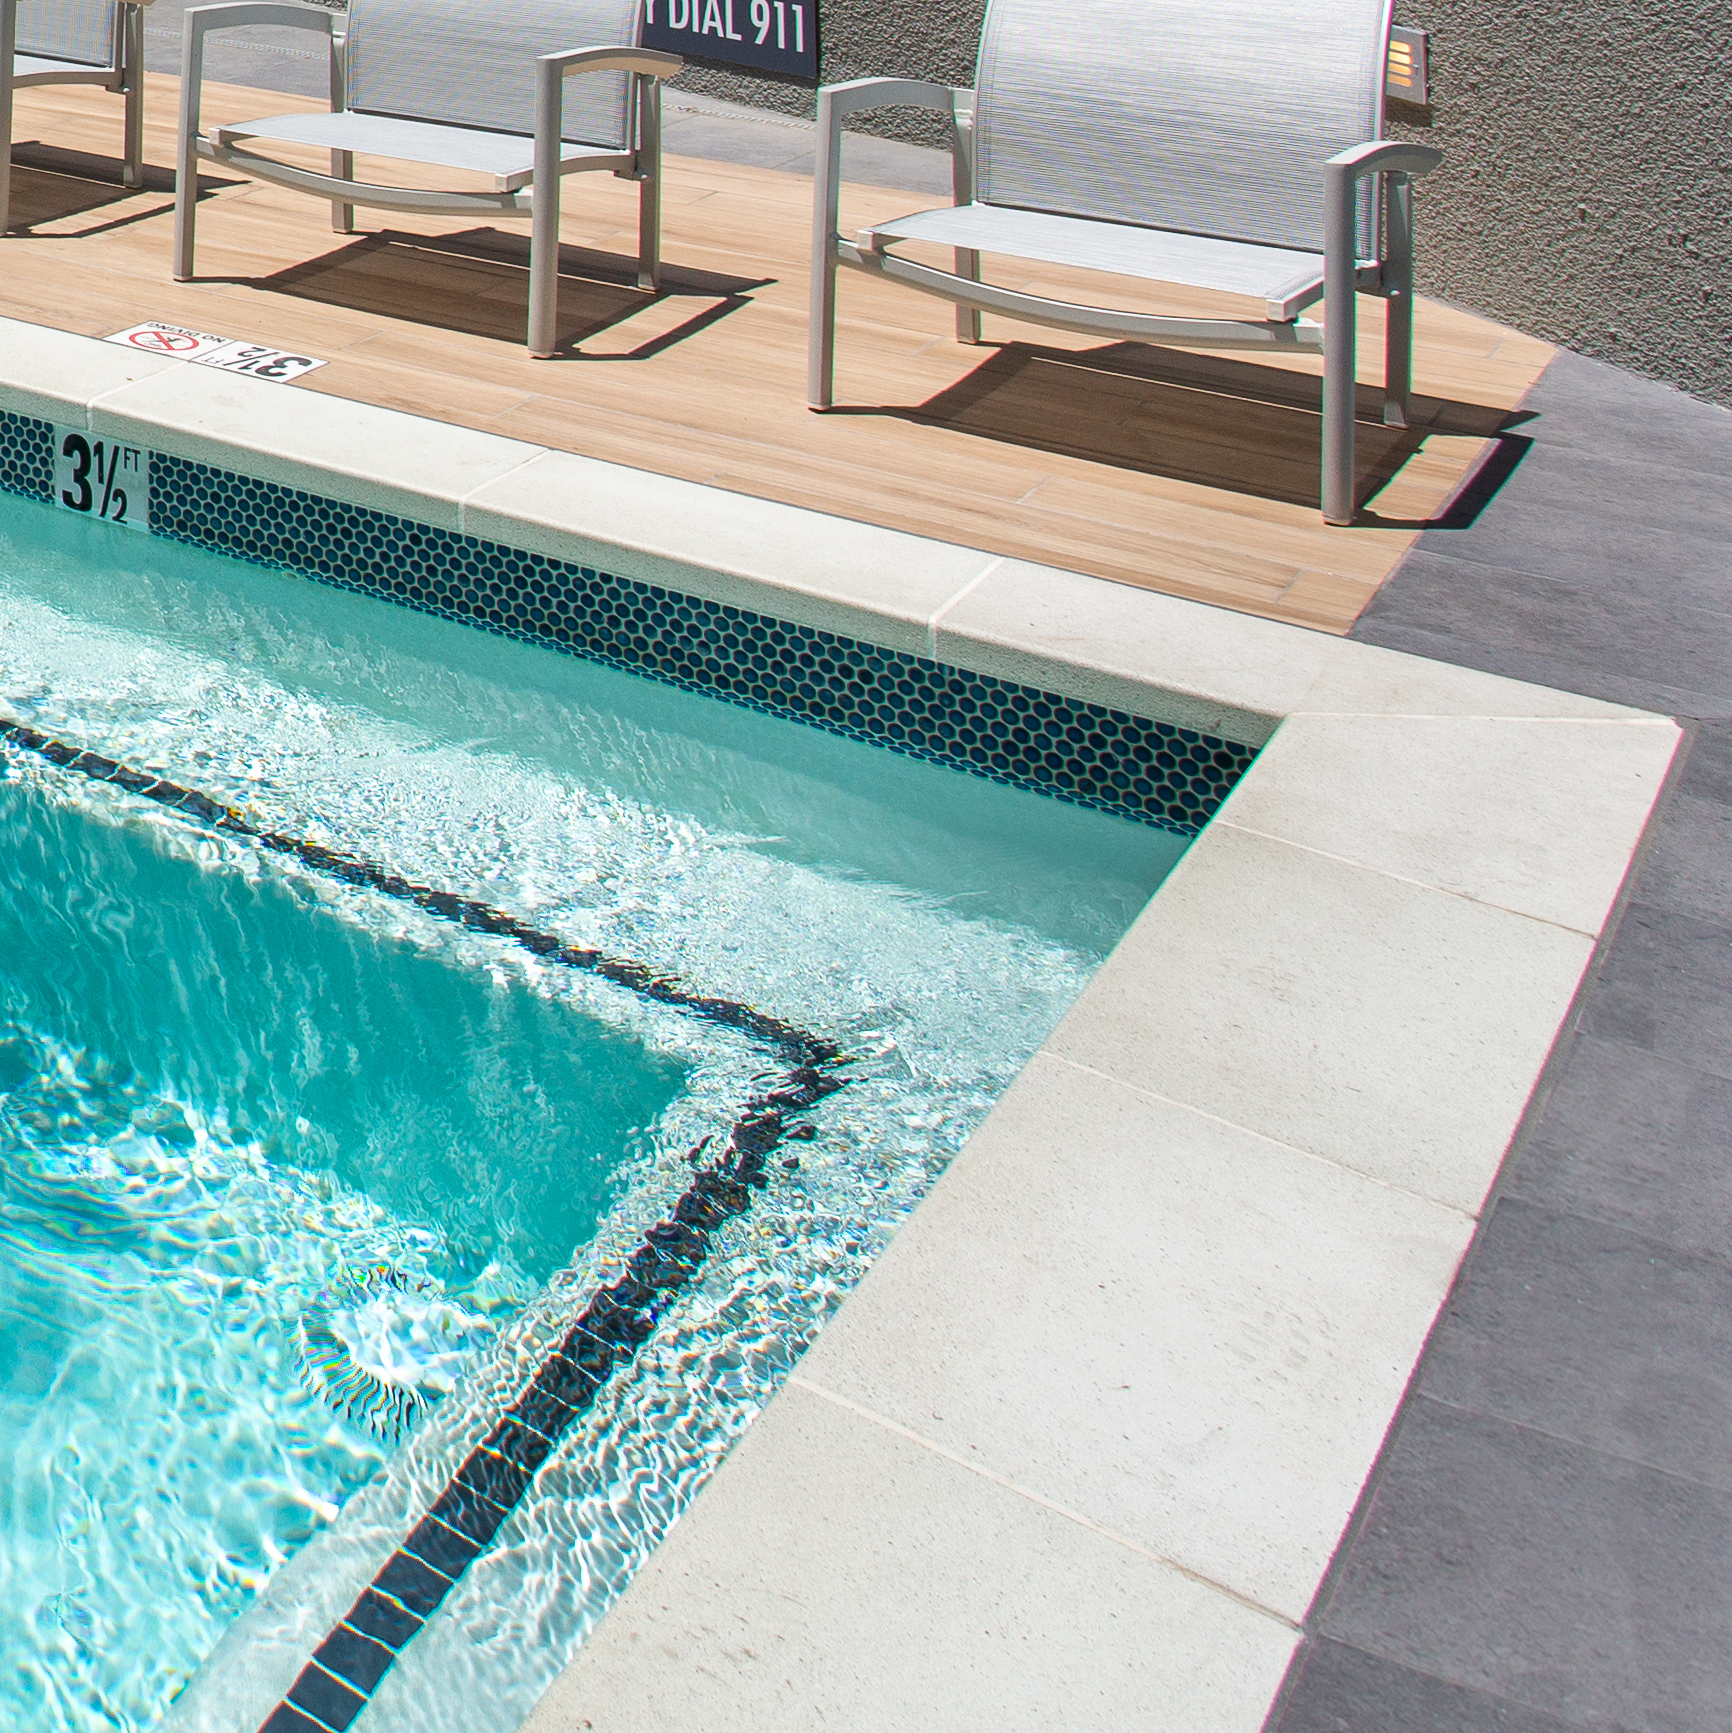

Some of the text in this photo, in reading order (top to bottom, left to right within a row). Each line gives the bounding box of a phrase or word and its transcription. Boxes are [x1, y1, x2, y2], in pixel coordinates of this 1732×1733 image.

[146, 322, 225, 344] NO DIVING
[123, 446, 141, 473] FT
